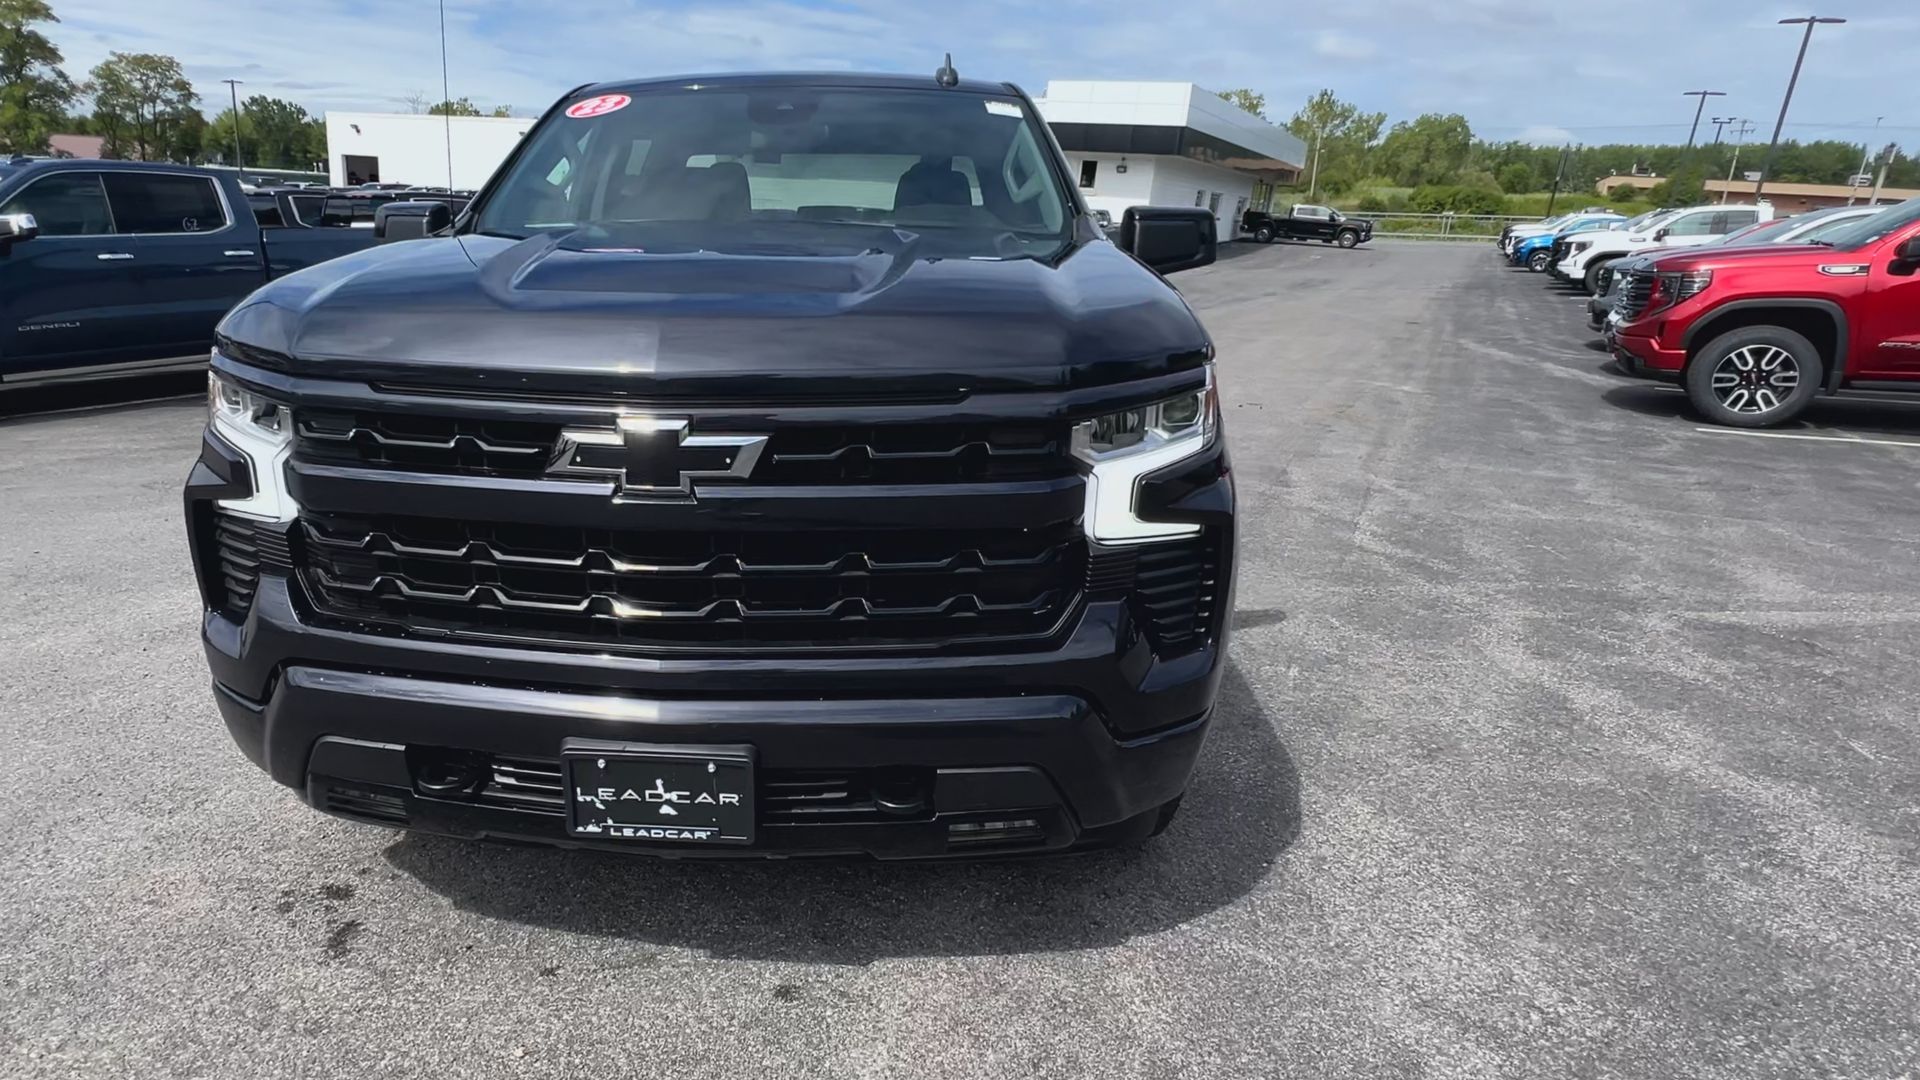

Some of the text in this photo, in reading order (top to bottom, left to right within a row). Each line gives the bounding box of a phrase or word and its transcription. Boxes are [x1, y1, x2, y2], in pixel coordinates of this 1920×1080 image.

[18, 321, 80, 331] DENALI
[576, 786, 741, 806] LEADCAR
[609, 827, 711, 840] LEADCAR
